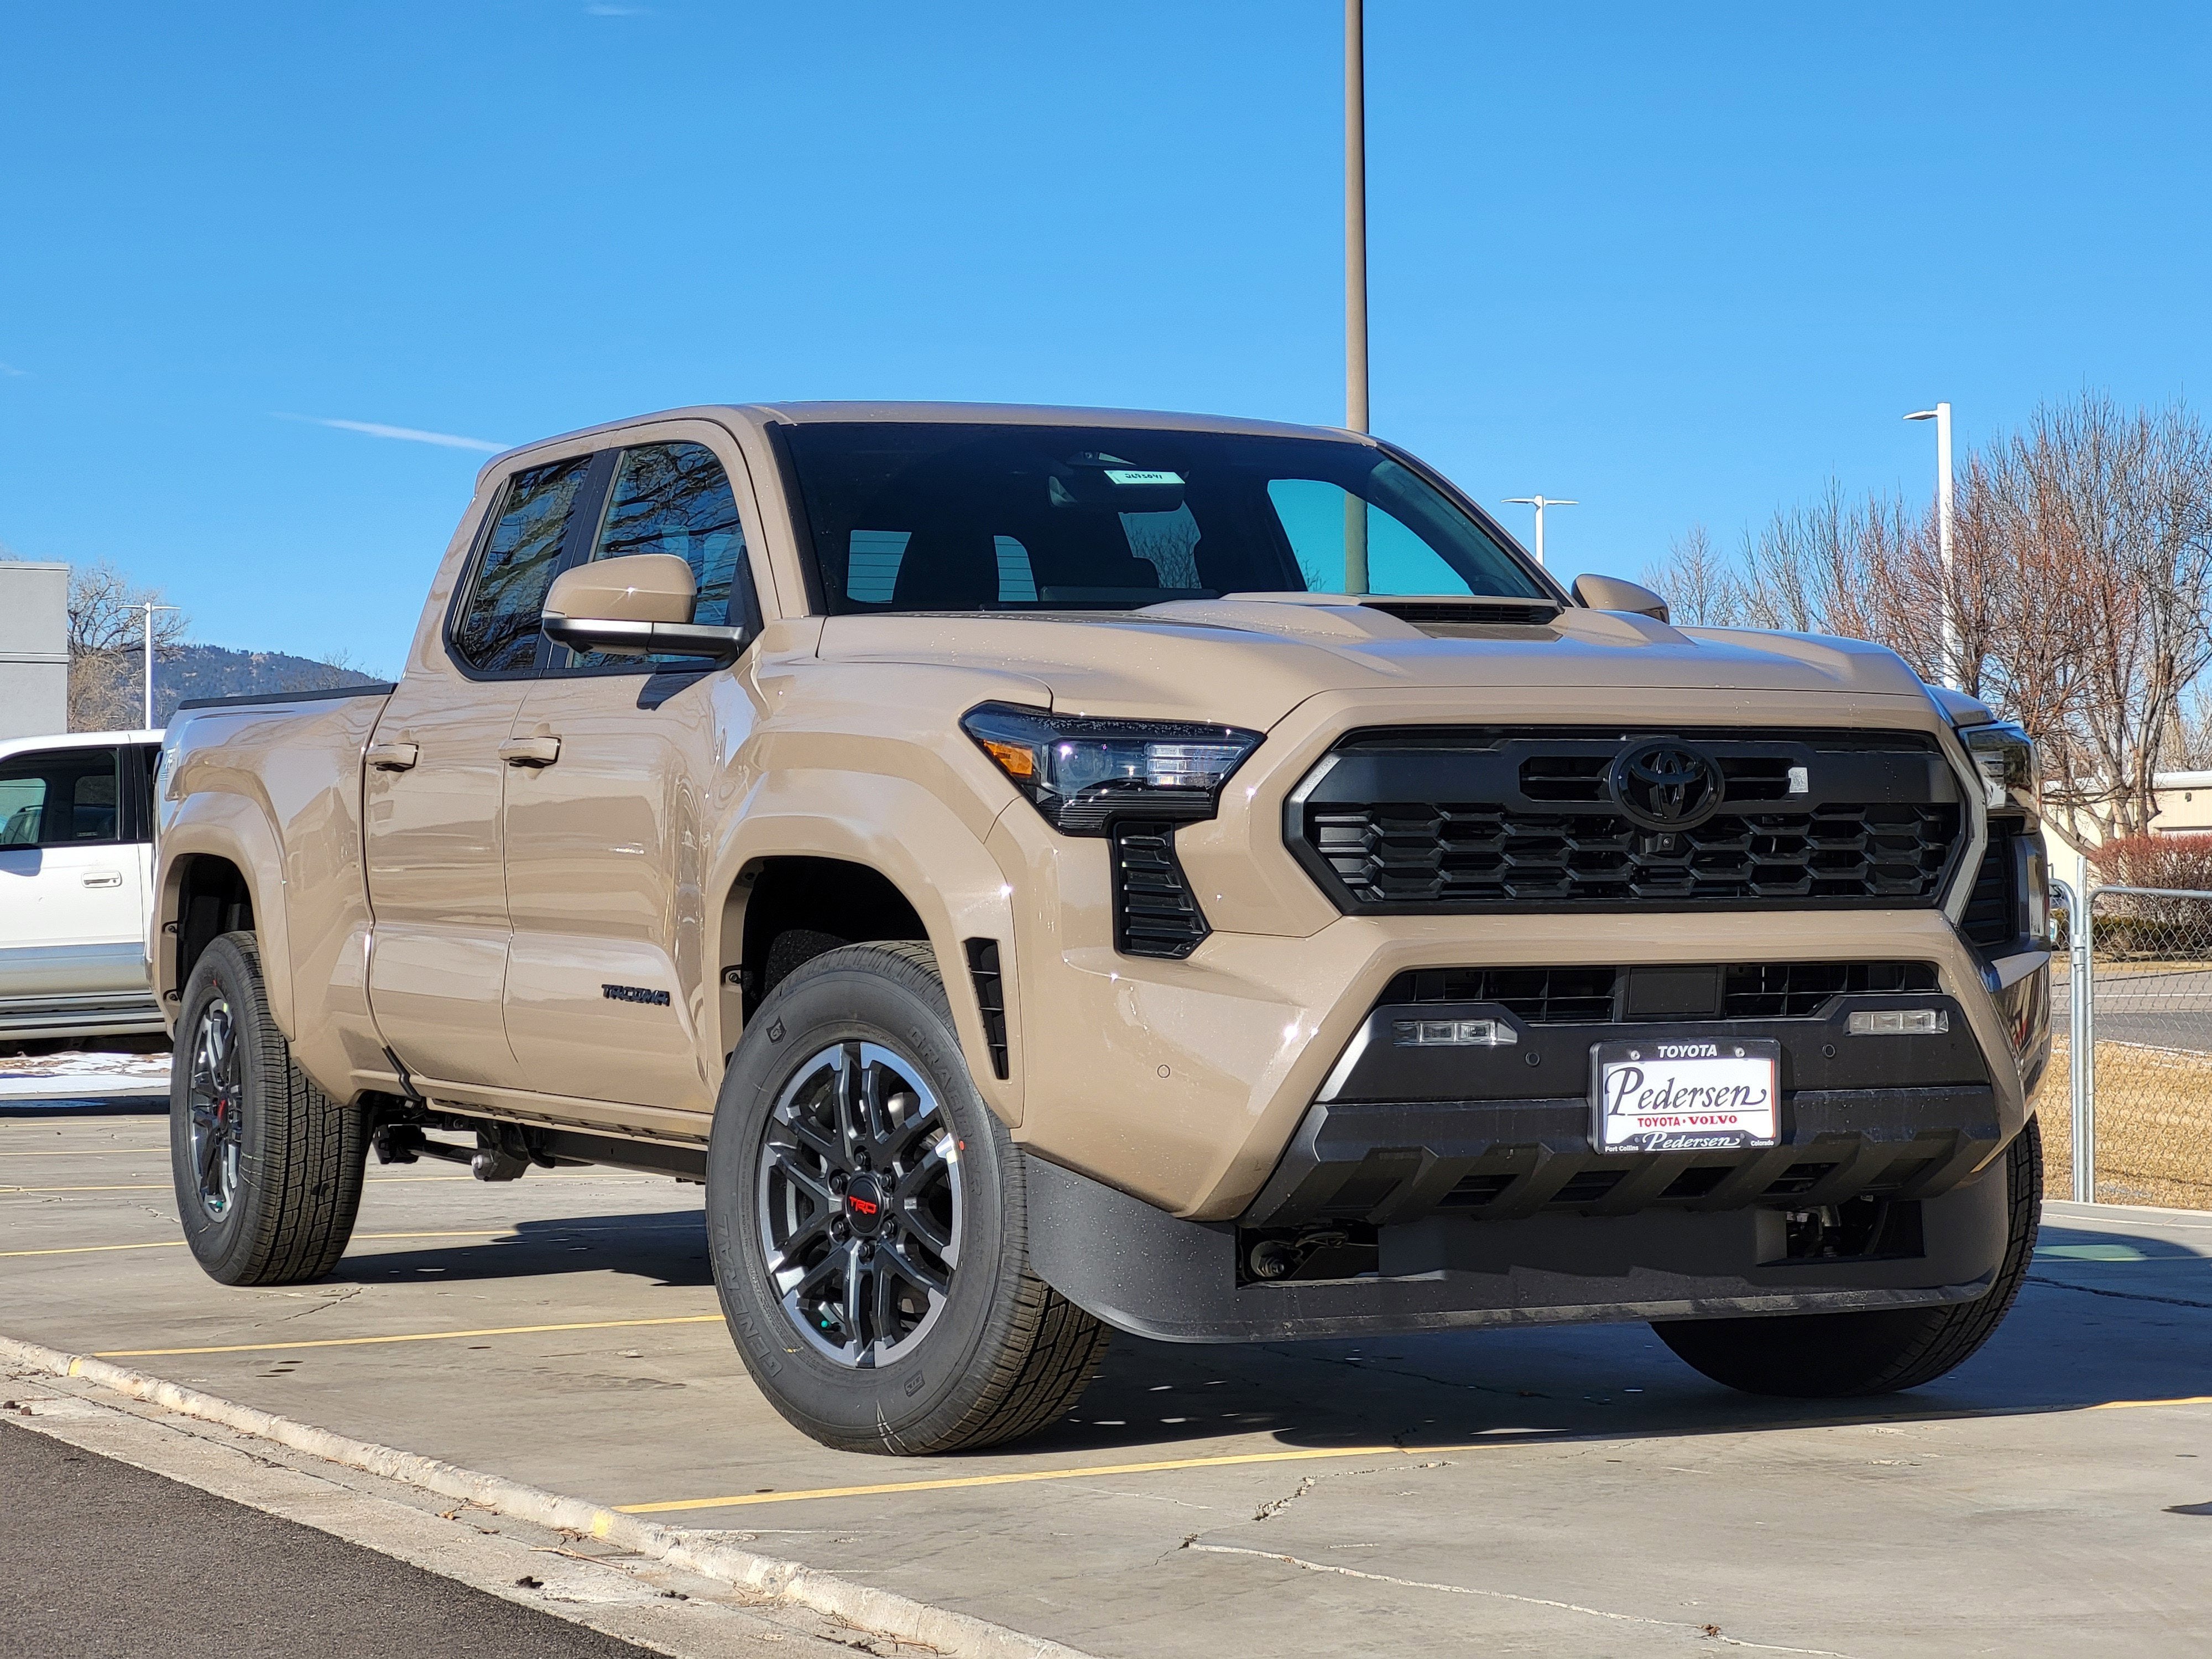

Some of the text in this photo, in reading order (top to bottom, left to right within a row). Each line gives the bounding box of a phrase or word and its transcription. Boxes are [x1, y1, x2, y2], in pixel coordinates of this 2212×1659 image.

[601, 984, 670, 1006] TACOMA
[1657, 1044, 1718, 1059] TOYOTA
[1604, 1066, 1767, 1117] Pedersen
[1637, 1114, 1738, 1128] TOYOTA VOLVO
[1642, 1131, 1741, 1151] Pedersen
[849, 1196, 877, 1214] TRD
[718, 1213, 782, 1378] GENERAL
